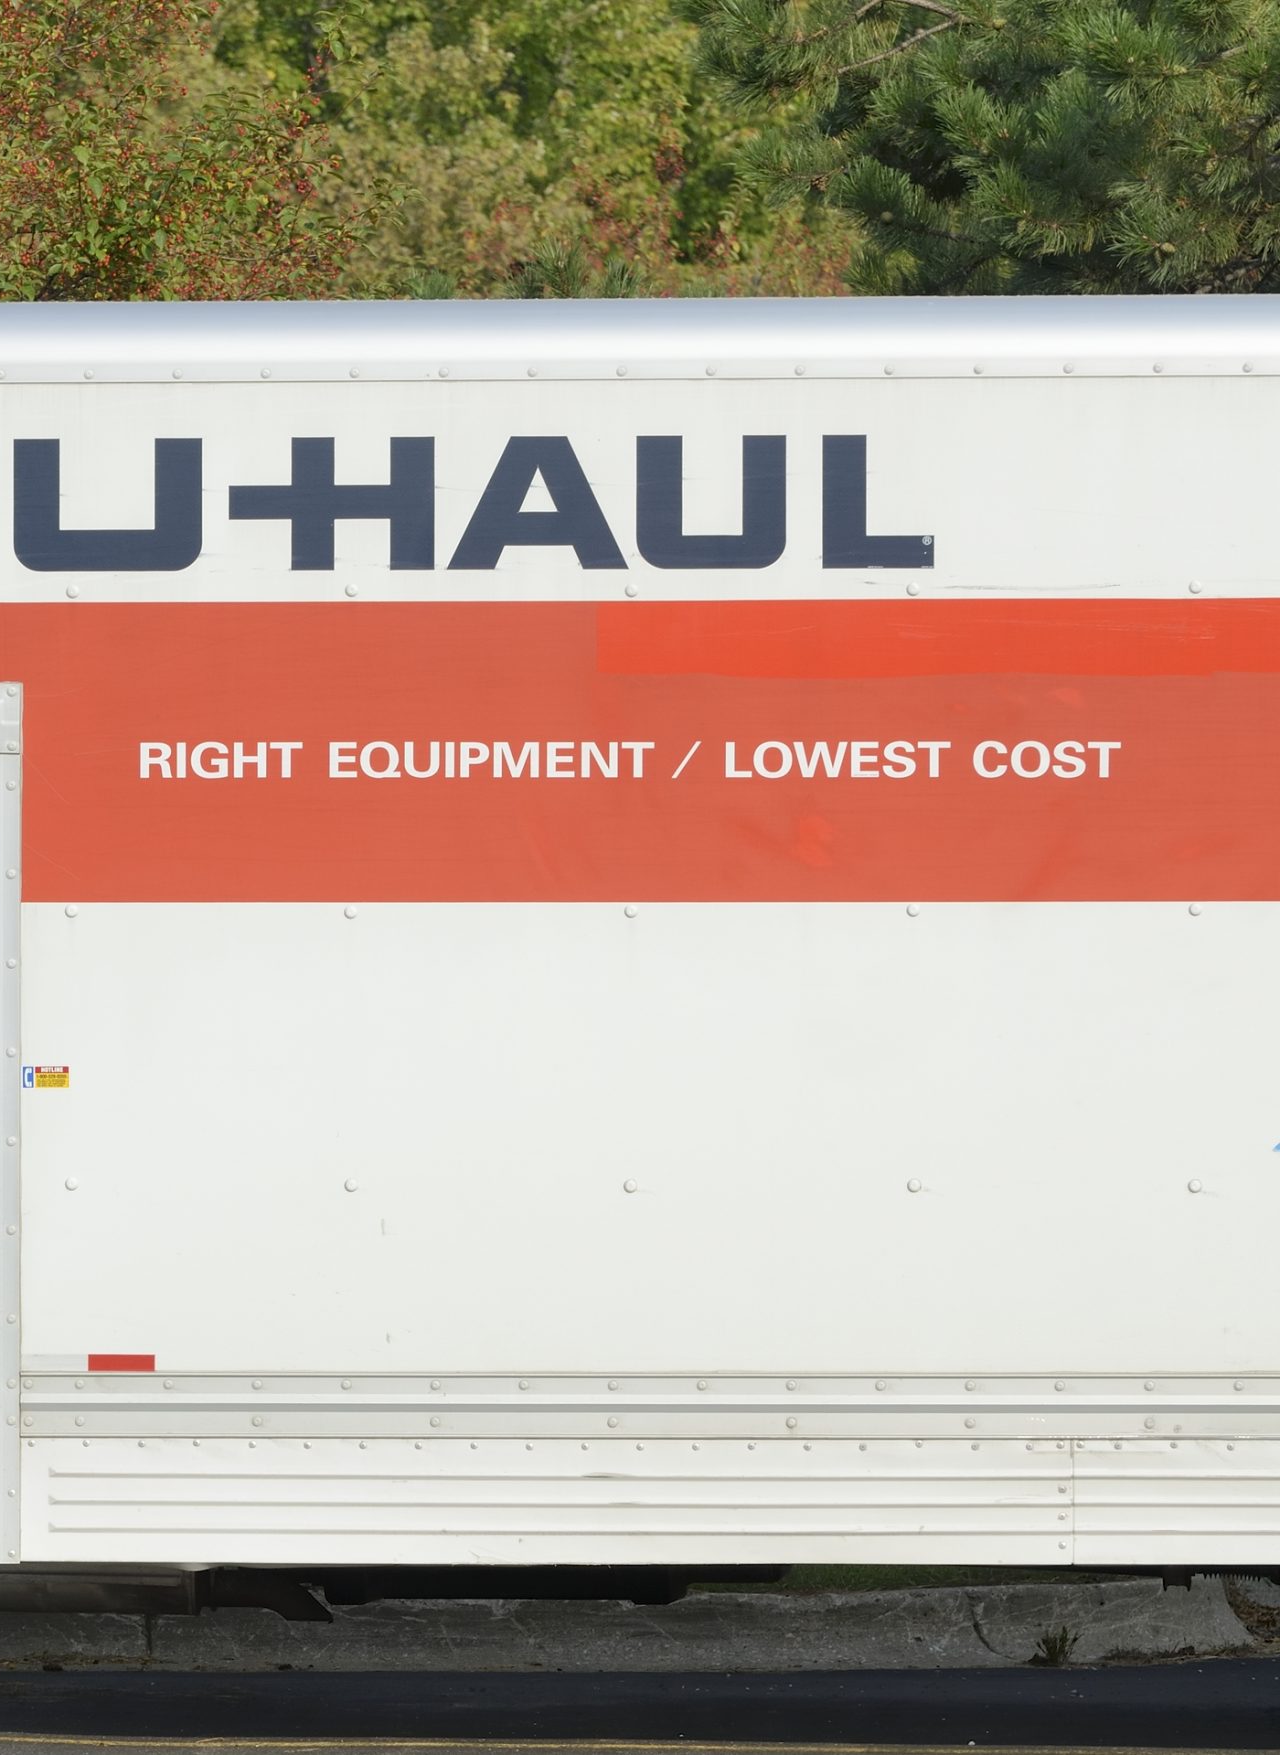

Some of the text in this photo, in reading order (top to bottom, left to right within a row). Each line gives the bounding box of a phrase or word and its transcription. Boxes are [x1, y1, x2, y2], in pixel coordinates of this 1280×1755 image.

[13, 434, 935, 572] U-HAUL
[139, 740, 1122, 779] RIGHT EQUIPMENT / LOWEST COST
